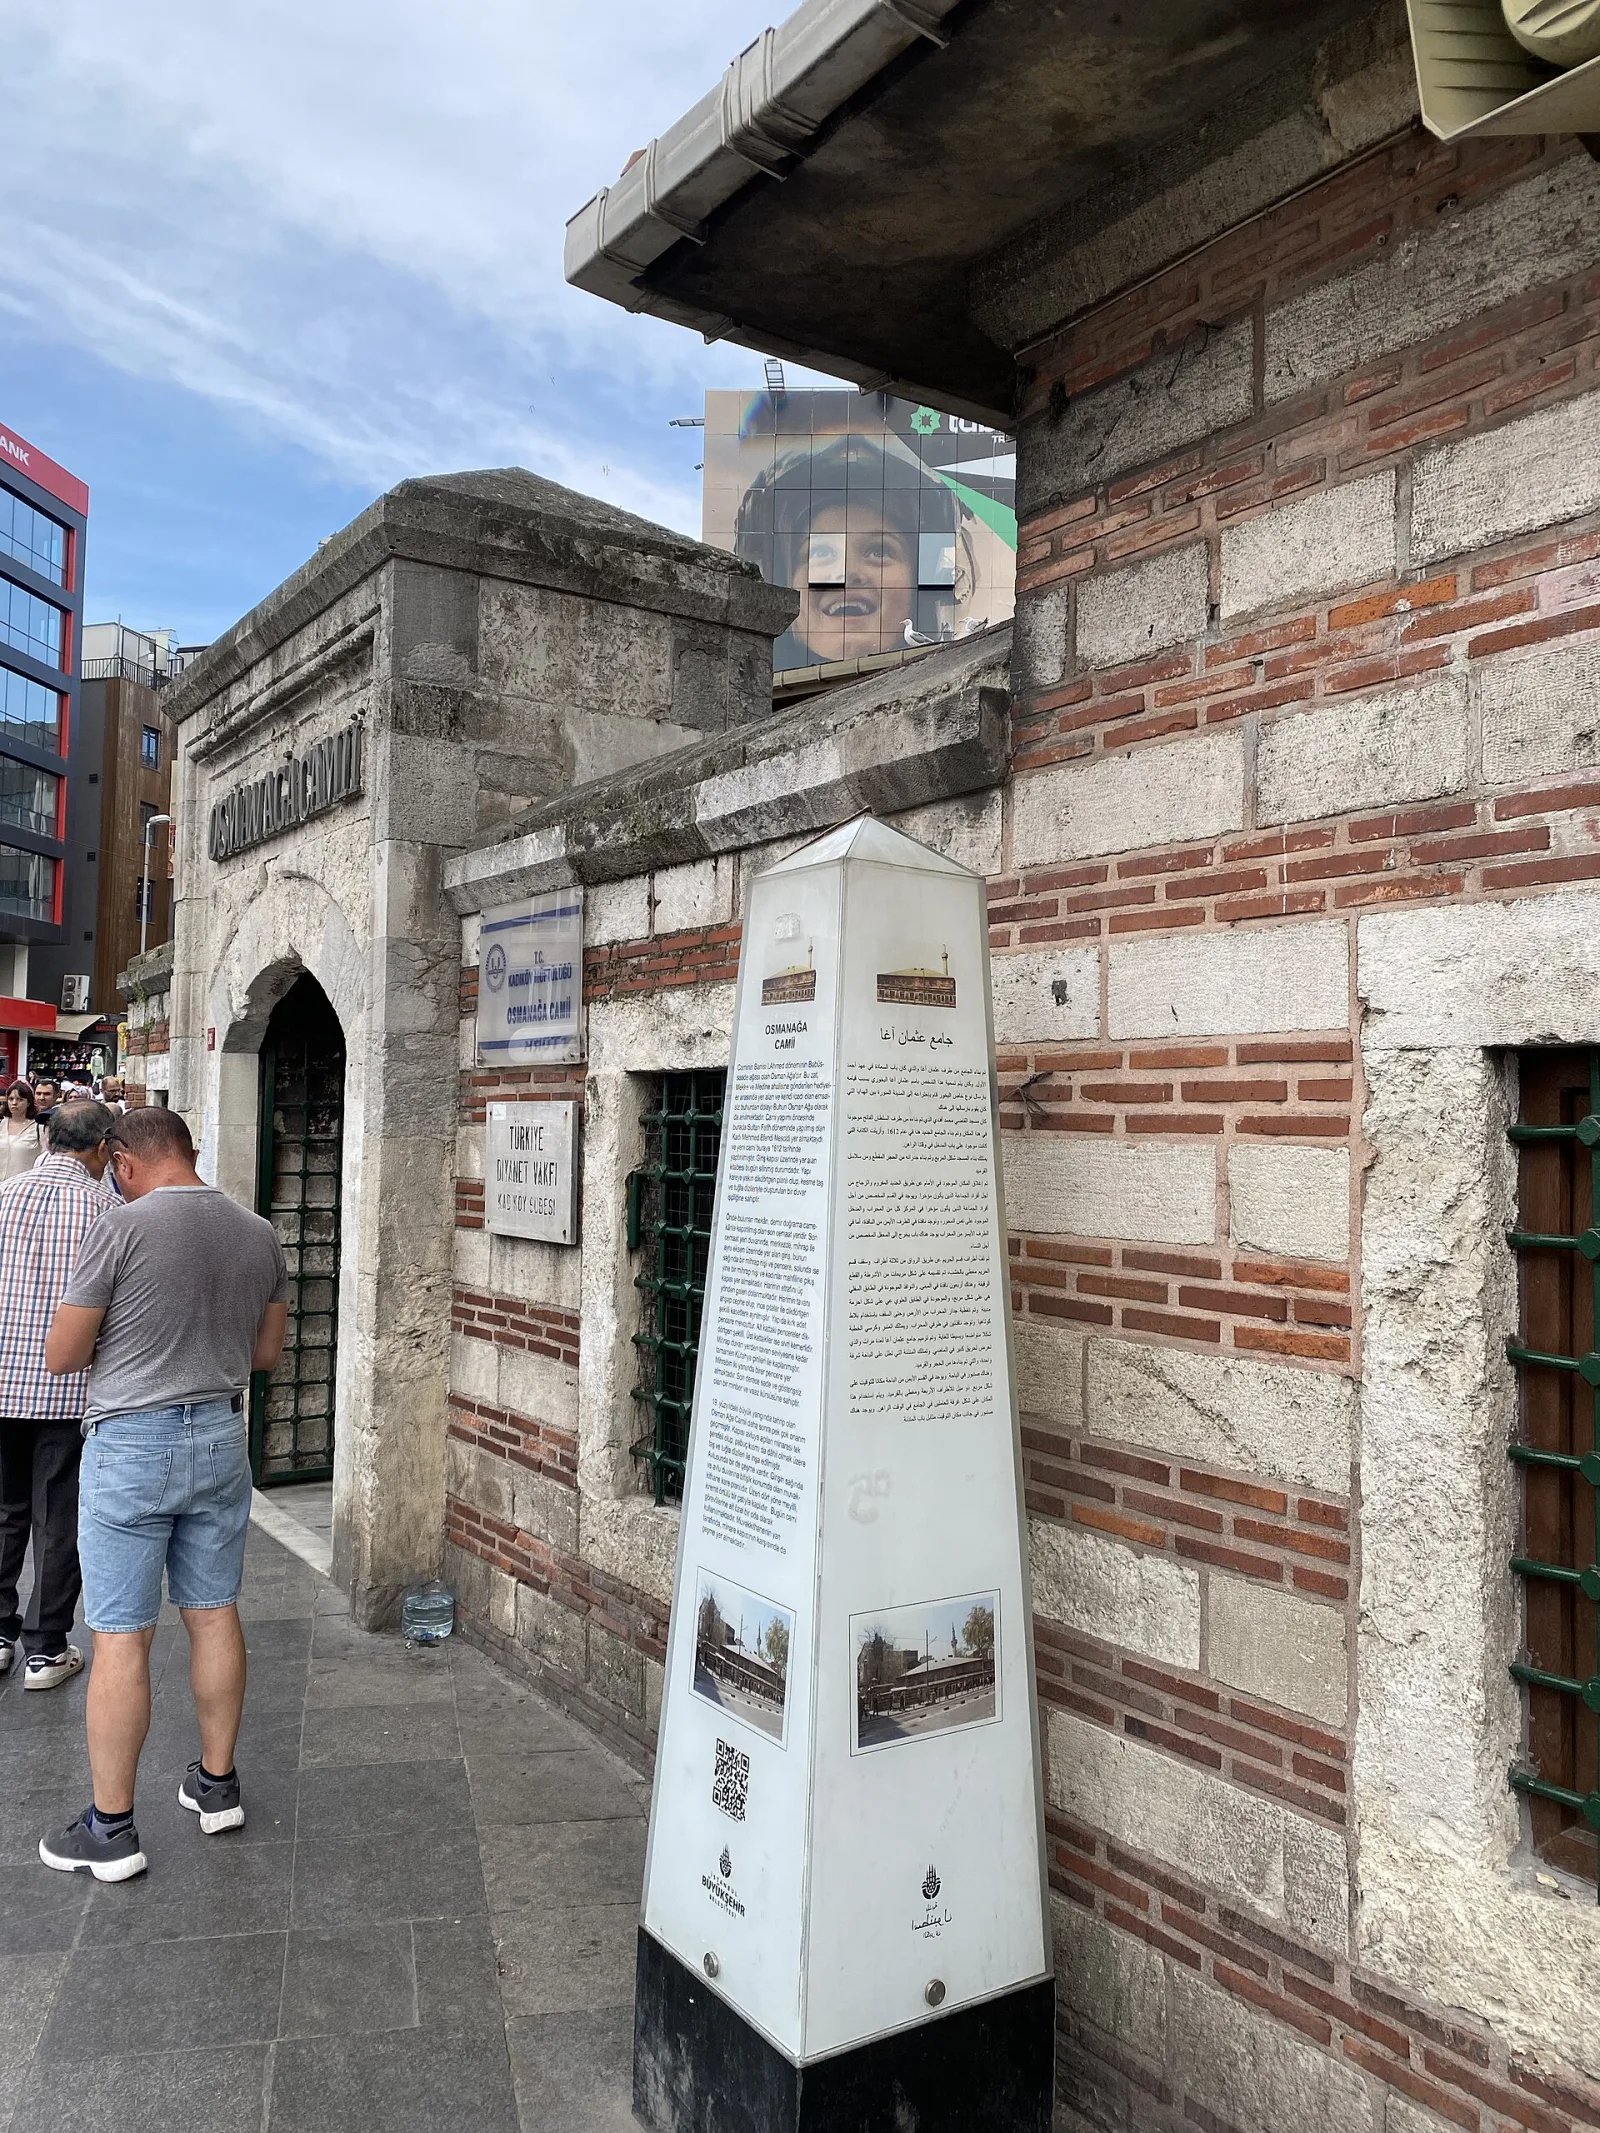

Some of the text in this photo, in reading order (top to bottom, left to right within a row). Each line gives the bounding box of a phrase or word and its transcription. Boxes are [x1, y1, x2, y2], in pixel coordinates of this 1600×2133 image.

[533, 950, 545, 964] T.C.
[508, 969, 533, 987] KADIKÖY
[507, 999, 547, 1025] OSMANAĞA
[765, 1020, 808, 1035] OSMANAĞA
[898, 1029, 926, 1045] عثمان
[929, 1032, 954, 1050] جامع
[754, 1082, 770, 1090] Medine
[787, 1102, 804, 1110] Osman
[510, 1121, 544, 1151] TÜRKİYE
[741, 1133, 759, 1141] Mehmed
[771, 1144, 782, 1152] 1612
[533, 1161, 558, 1187] VAKFI
[701, 1874, 745, 1917] BÜYÜKŞEHİR
[709, 1894, 737, 1919] BELEDİYESİ
